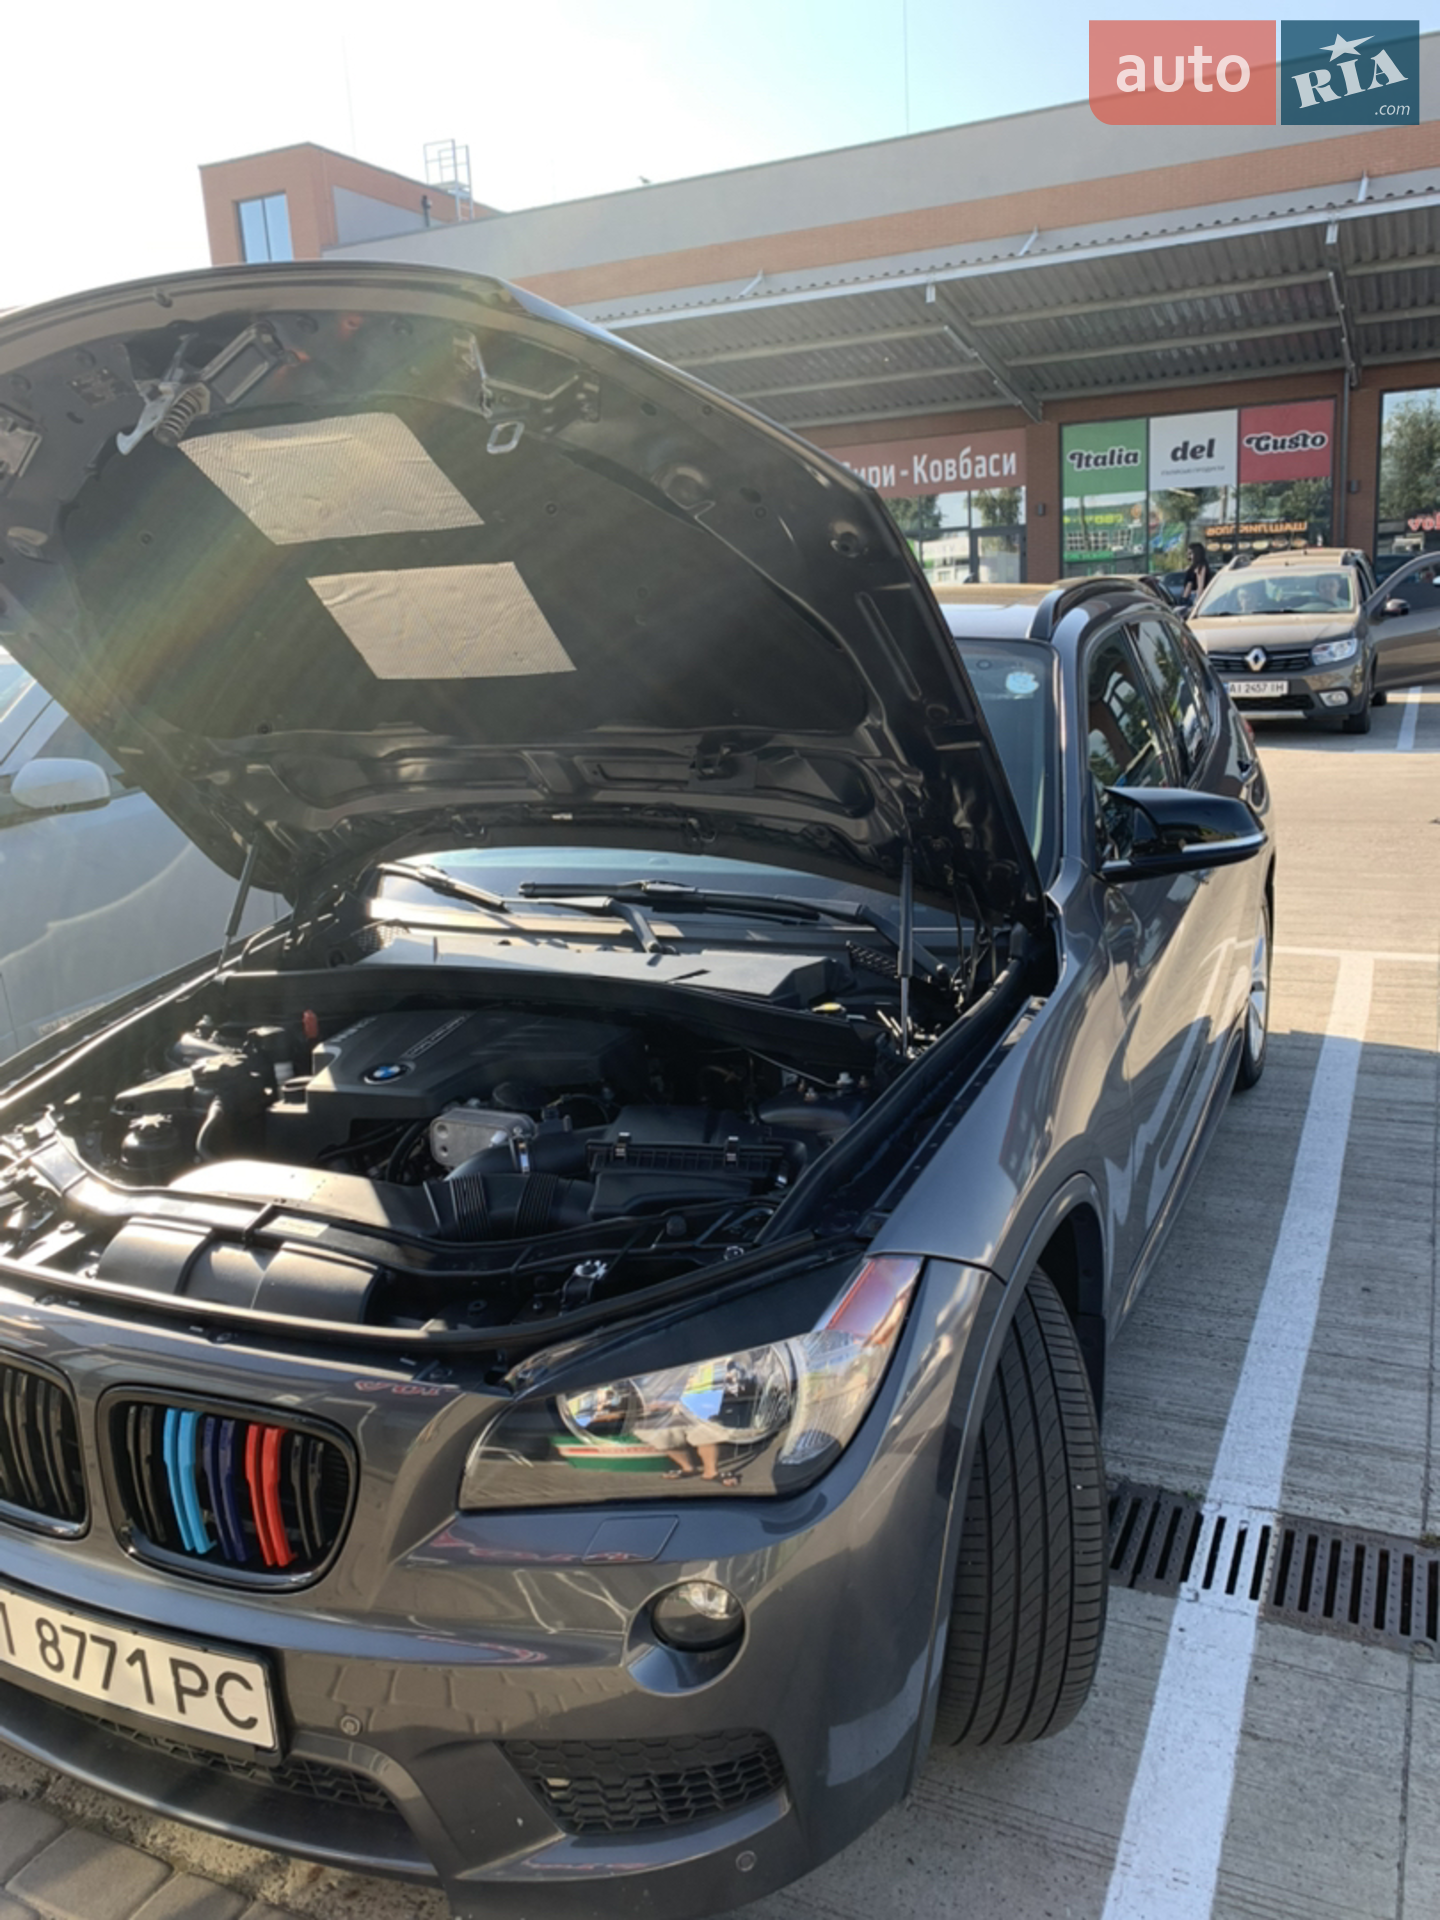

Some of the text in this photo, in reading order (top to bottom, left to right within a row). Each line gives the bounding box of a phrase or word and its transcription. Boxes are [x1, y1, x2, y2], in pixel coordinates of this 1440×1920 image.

[1068, 430, 1327, 470] Italia del Gusto
[35, 1617, 154, 1705] 8771
[169, 1657, 258, 1730] PC
